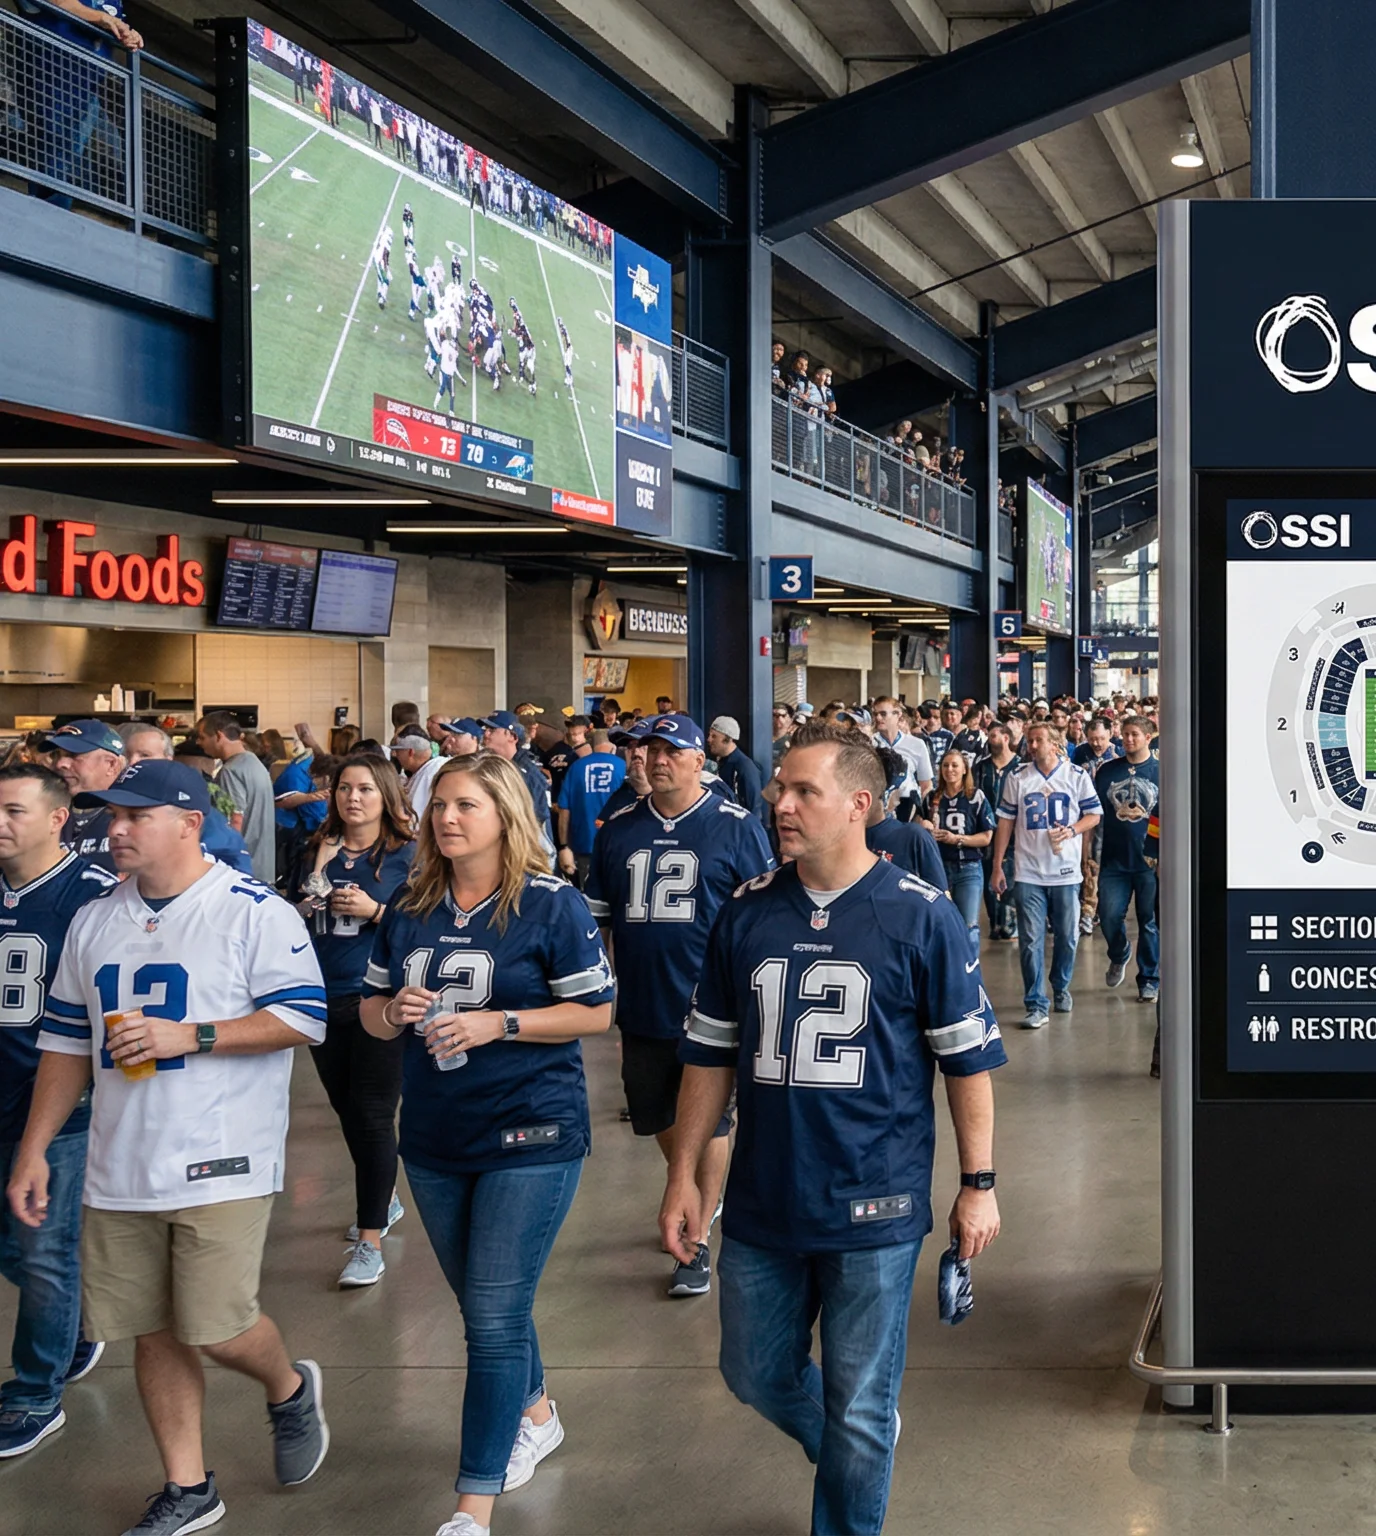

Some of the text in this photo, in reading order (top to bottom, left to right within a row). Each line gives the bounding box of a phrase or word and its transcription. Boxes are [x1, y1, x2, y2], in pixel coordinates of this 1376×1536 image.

[1241, 511, 1351, 549] OSSI
[58, 519, 205, 607] Foods
[781, 565, 802, 593] 3
[1288, 648, 1299, 661] 3
[1277, 718, 1287, 731] 2
[1290, 790, 1297, 802] 1
[626, 848, 700, 923] 12
[751, 957, 872, 1089] 12
